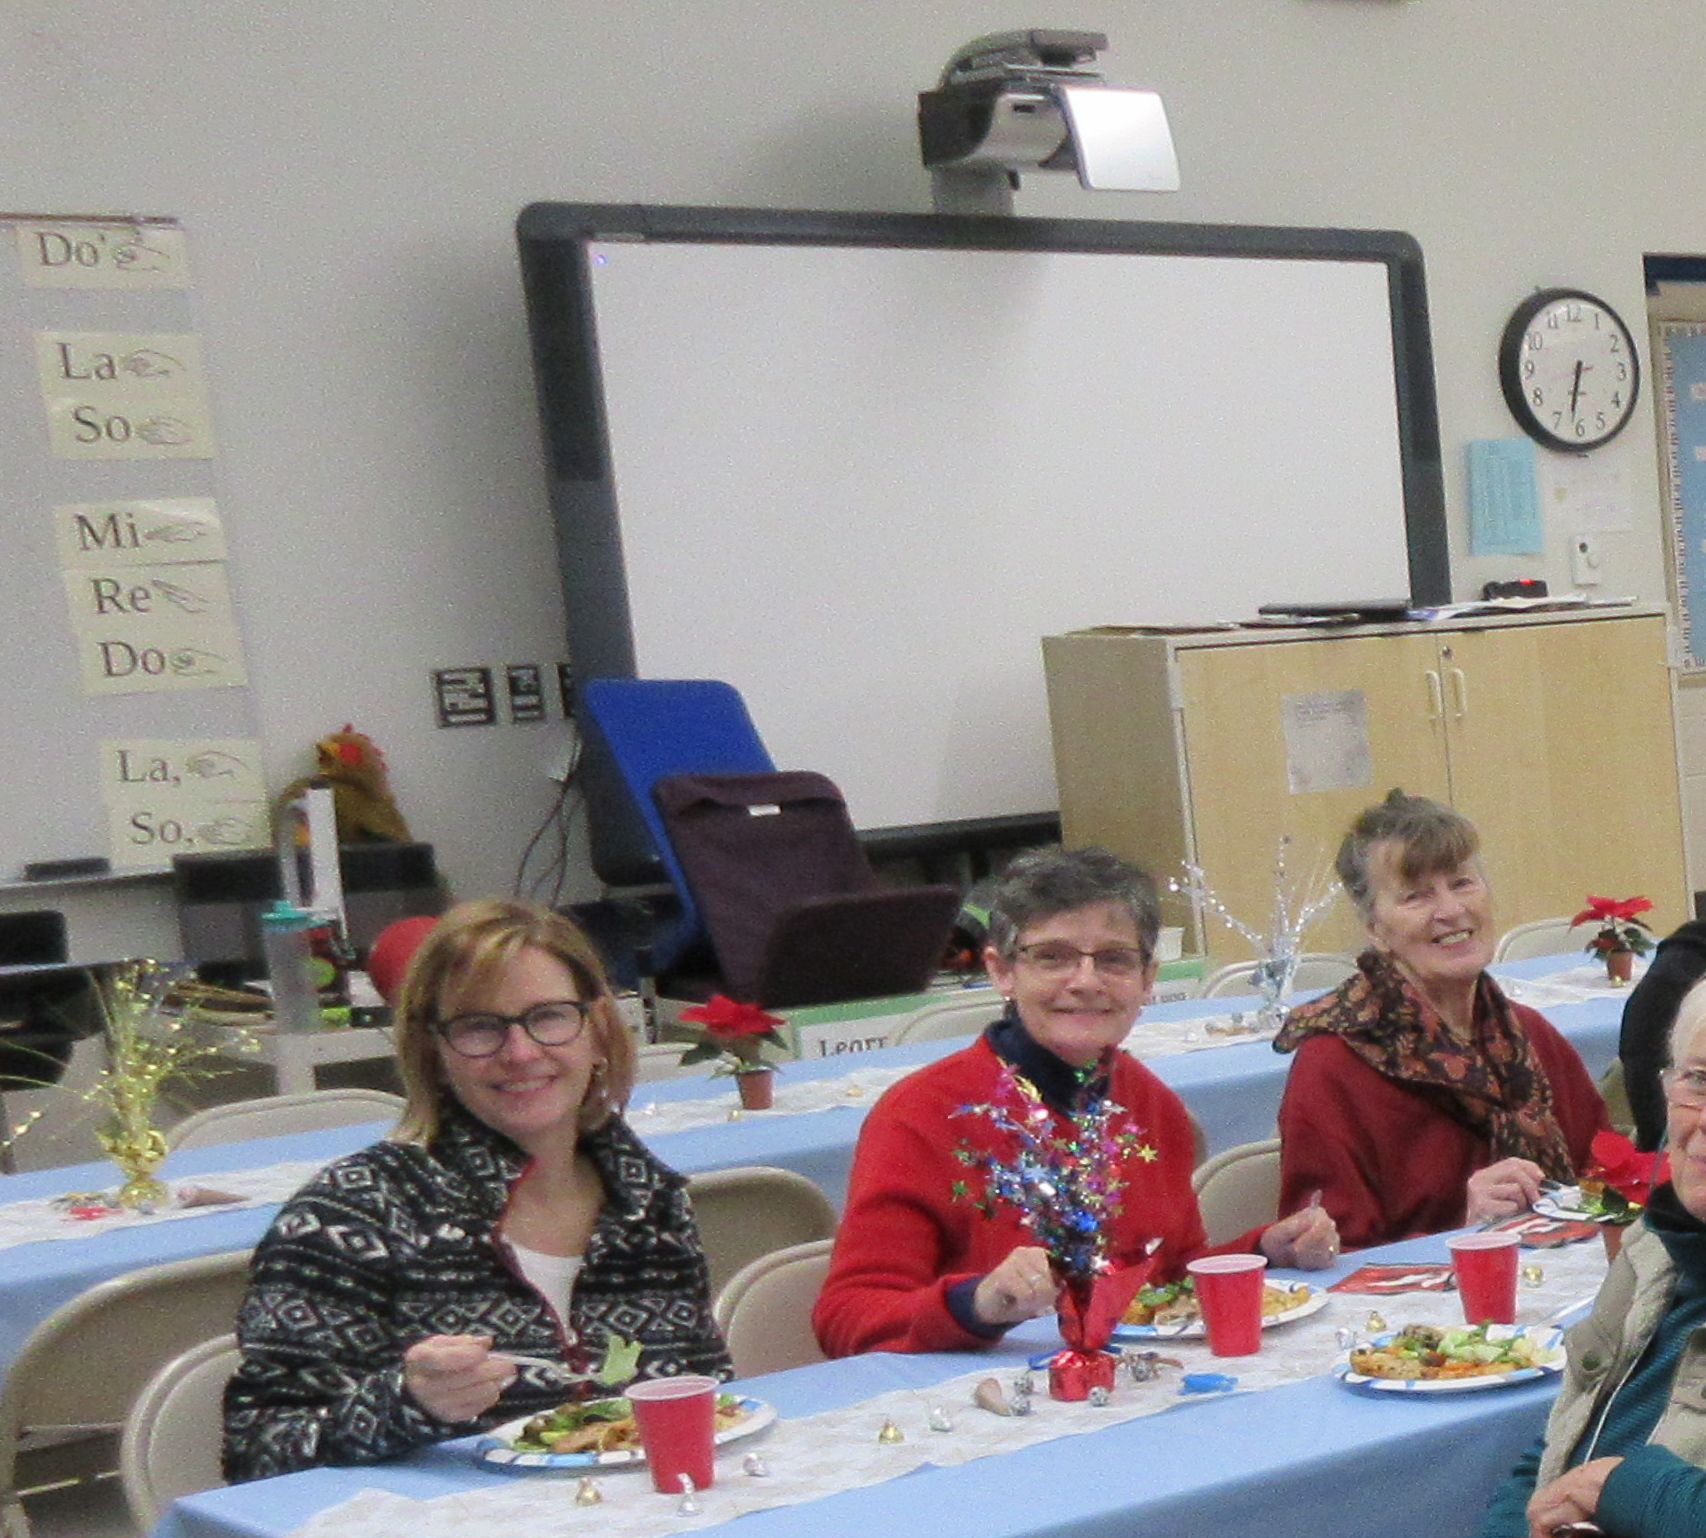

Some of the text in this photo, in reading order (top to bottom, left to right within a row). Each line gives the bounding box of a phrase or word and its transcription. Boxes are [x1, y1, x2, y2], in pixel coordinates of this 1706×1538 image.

[1566, 304, 1582, 322] 12
[1529, 332, 1543, 351] 10
[1610, 334, 1619, 353] 2
[57, 343, 117, 381] La
[1525, 361, 1534, 380] 9
[1618, 362, 1627, 381] 3
[1533, 387, 1543, 406] 8
[1611, 391, 1620, 408] 4
[74, 406, 131, 444] So
[1552, 411, 1562, 429] 7
[1575, 418, 1585, 437] 6
[1596, 411, 1606, 430] 5
[75, 512, 140, 552] Mi
[91, 576, 152, 614] Re
[99, 640, 167, 679] Do
